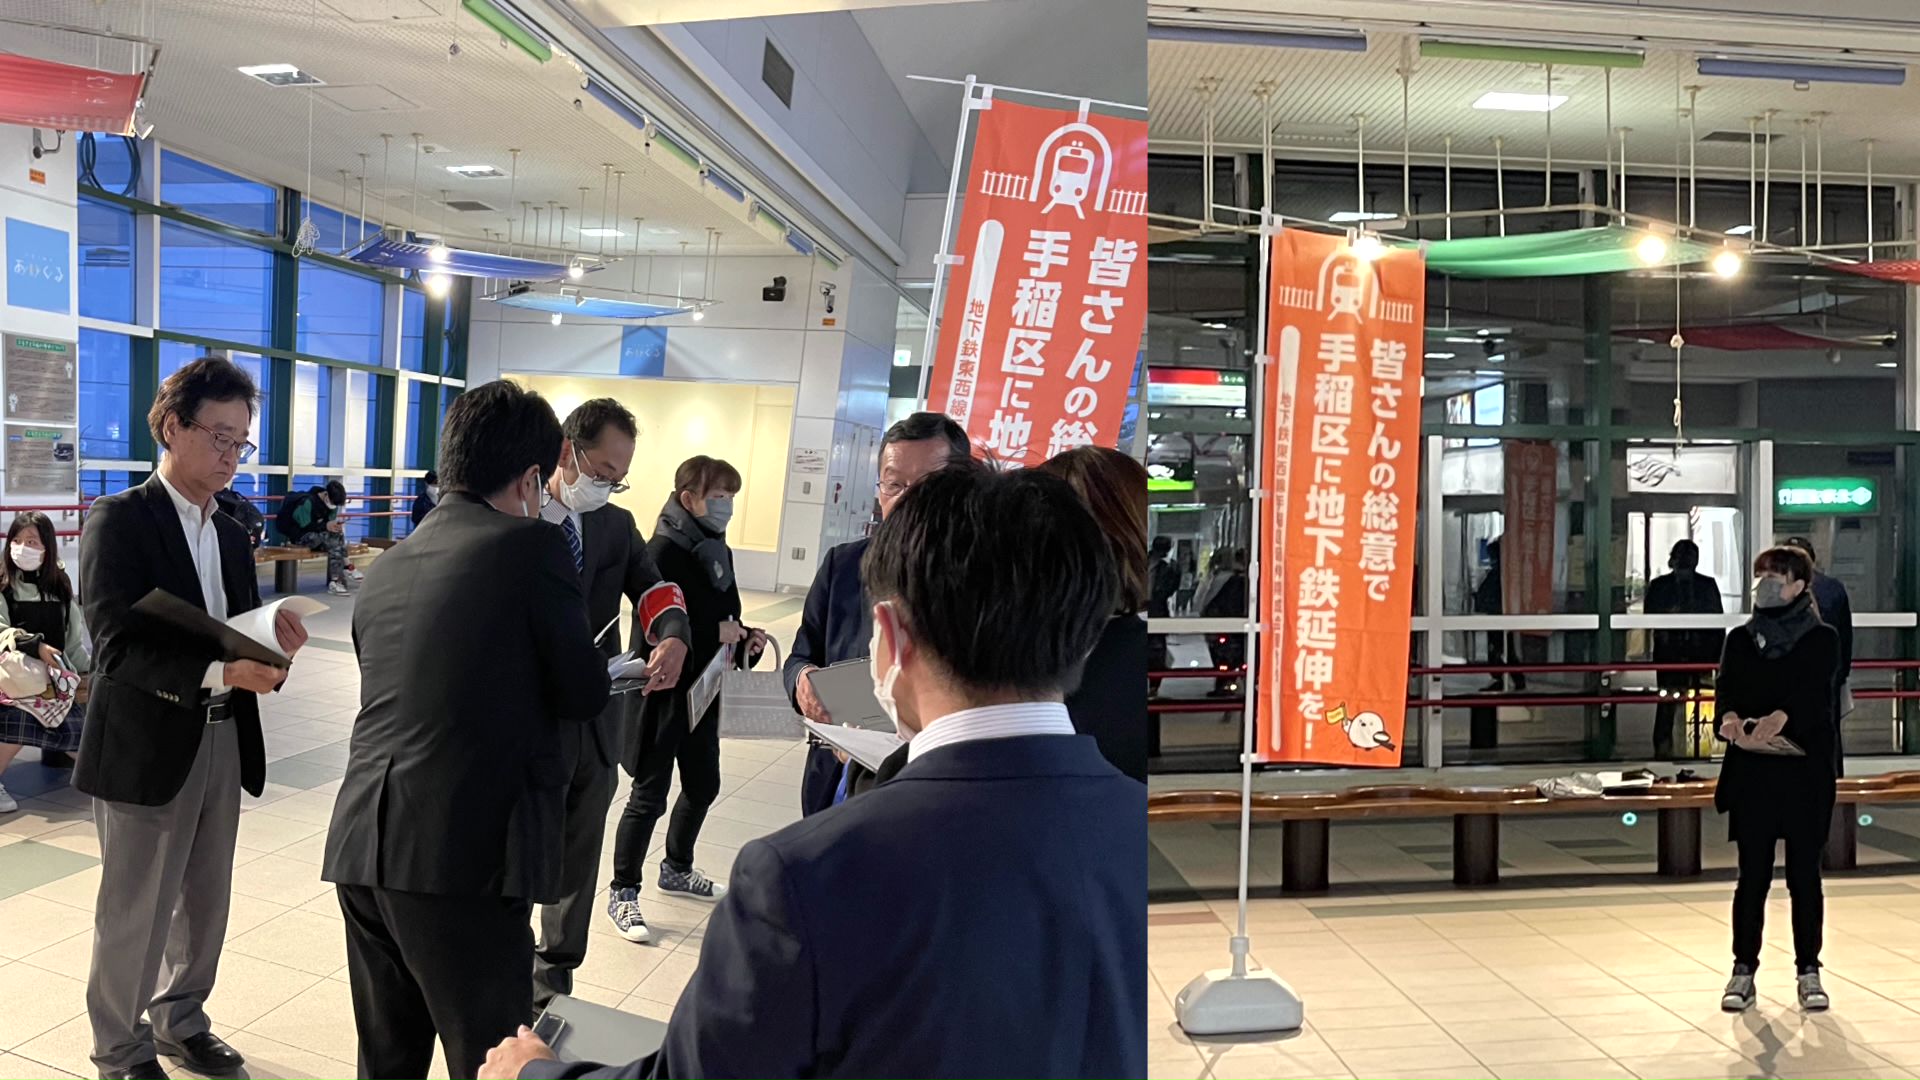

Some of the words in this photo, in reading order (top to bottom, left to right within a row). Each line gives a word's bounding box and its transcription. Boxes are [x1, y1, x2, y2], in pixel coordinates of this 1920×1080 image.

[949, 297, 985, 426] 地下鉄東西線
[1358, 338, 1408, 603] 皆さんの総意で
